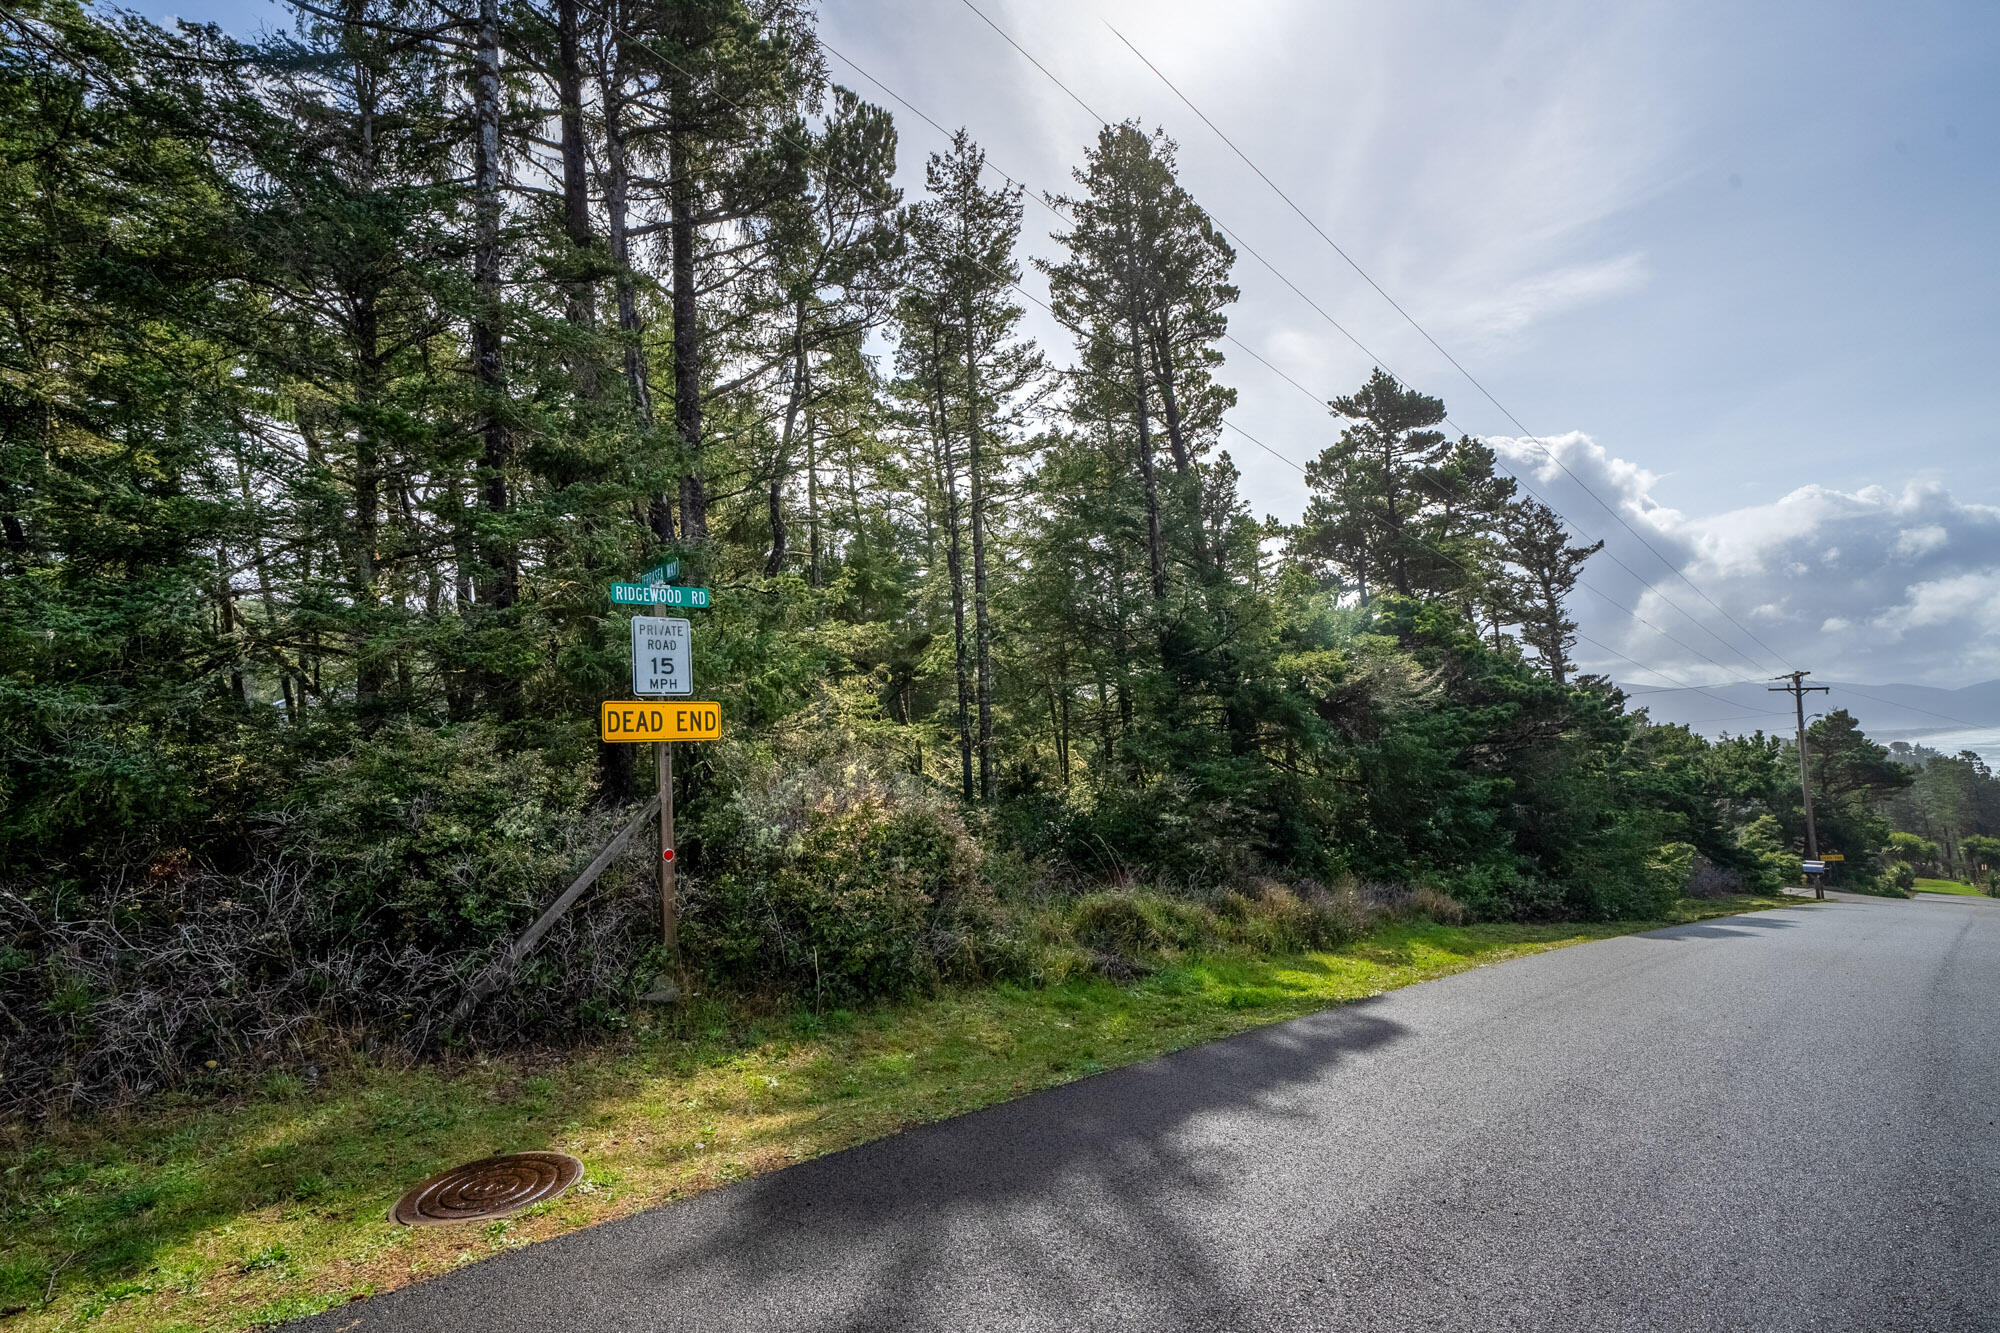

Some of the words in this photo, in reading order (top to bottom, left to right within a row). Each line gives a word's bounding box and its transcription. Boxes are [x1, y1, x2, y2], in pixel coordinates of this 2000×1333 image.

[666, 561, 677, 578] WAY
[615, 585, 682, 604] RIDGEWOOD
[691, 591, 706, 605] RD
[639, 624, 684, 637] PRIVATE
[647, 640, 677, 651] ROAD
[651, 658, 675, 675] 15
[649, 679, 678, 690] MPH
[607, 711, 663, 733] DEAD
[676, 711, 717, 732] END
